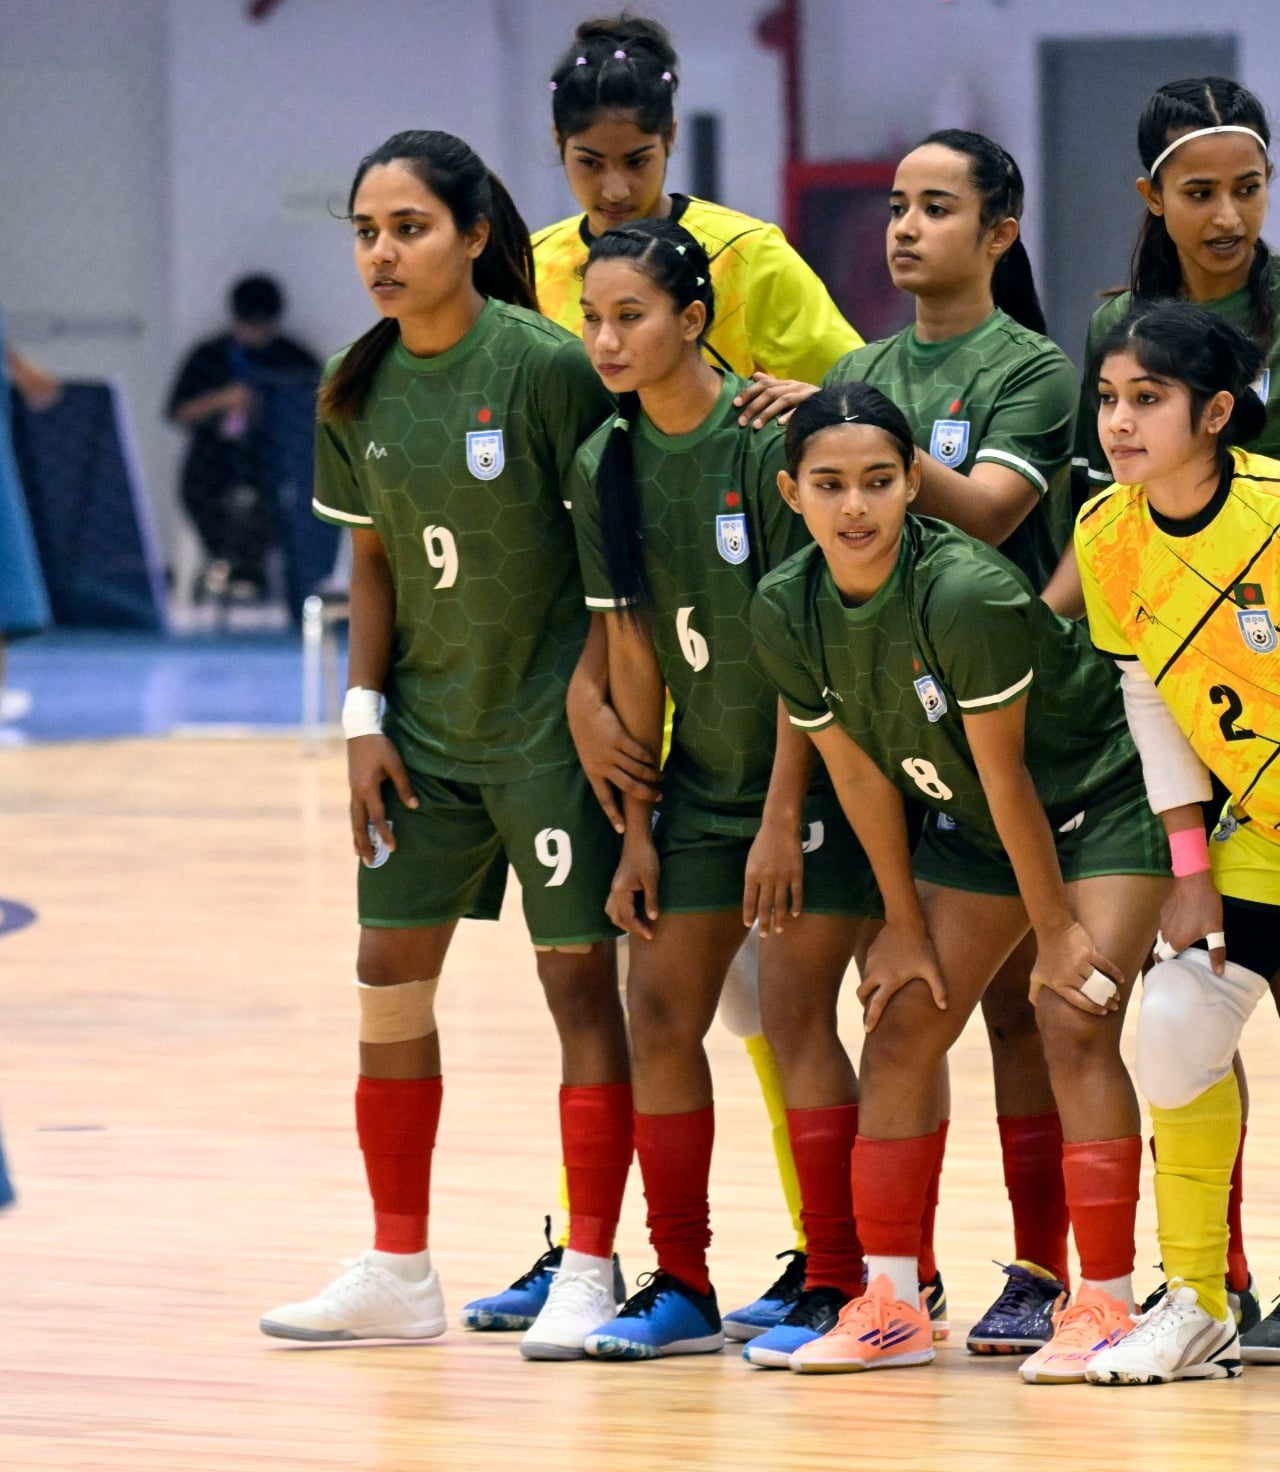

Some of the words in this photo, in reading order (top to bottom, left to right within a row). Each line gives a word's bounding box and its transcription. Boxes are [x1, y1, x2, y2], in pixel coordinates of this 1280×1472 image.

[423, 525, 459, 590] 9
[676, 606, 710, 673] 6
[1210, 685, 1256, 741] 2
[901, 757, 953, 801] 8
[534, 827, 573, 888] 9
